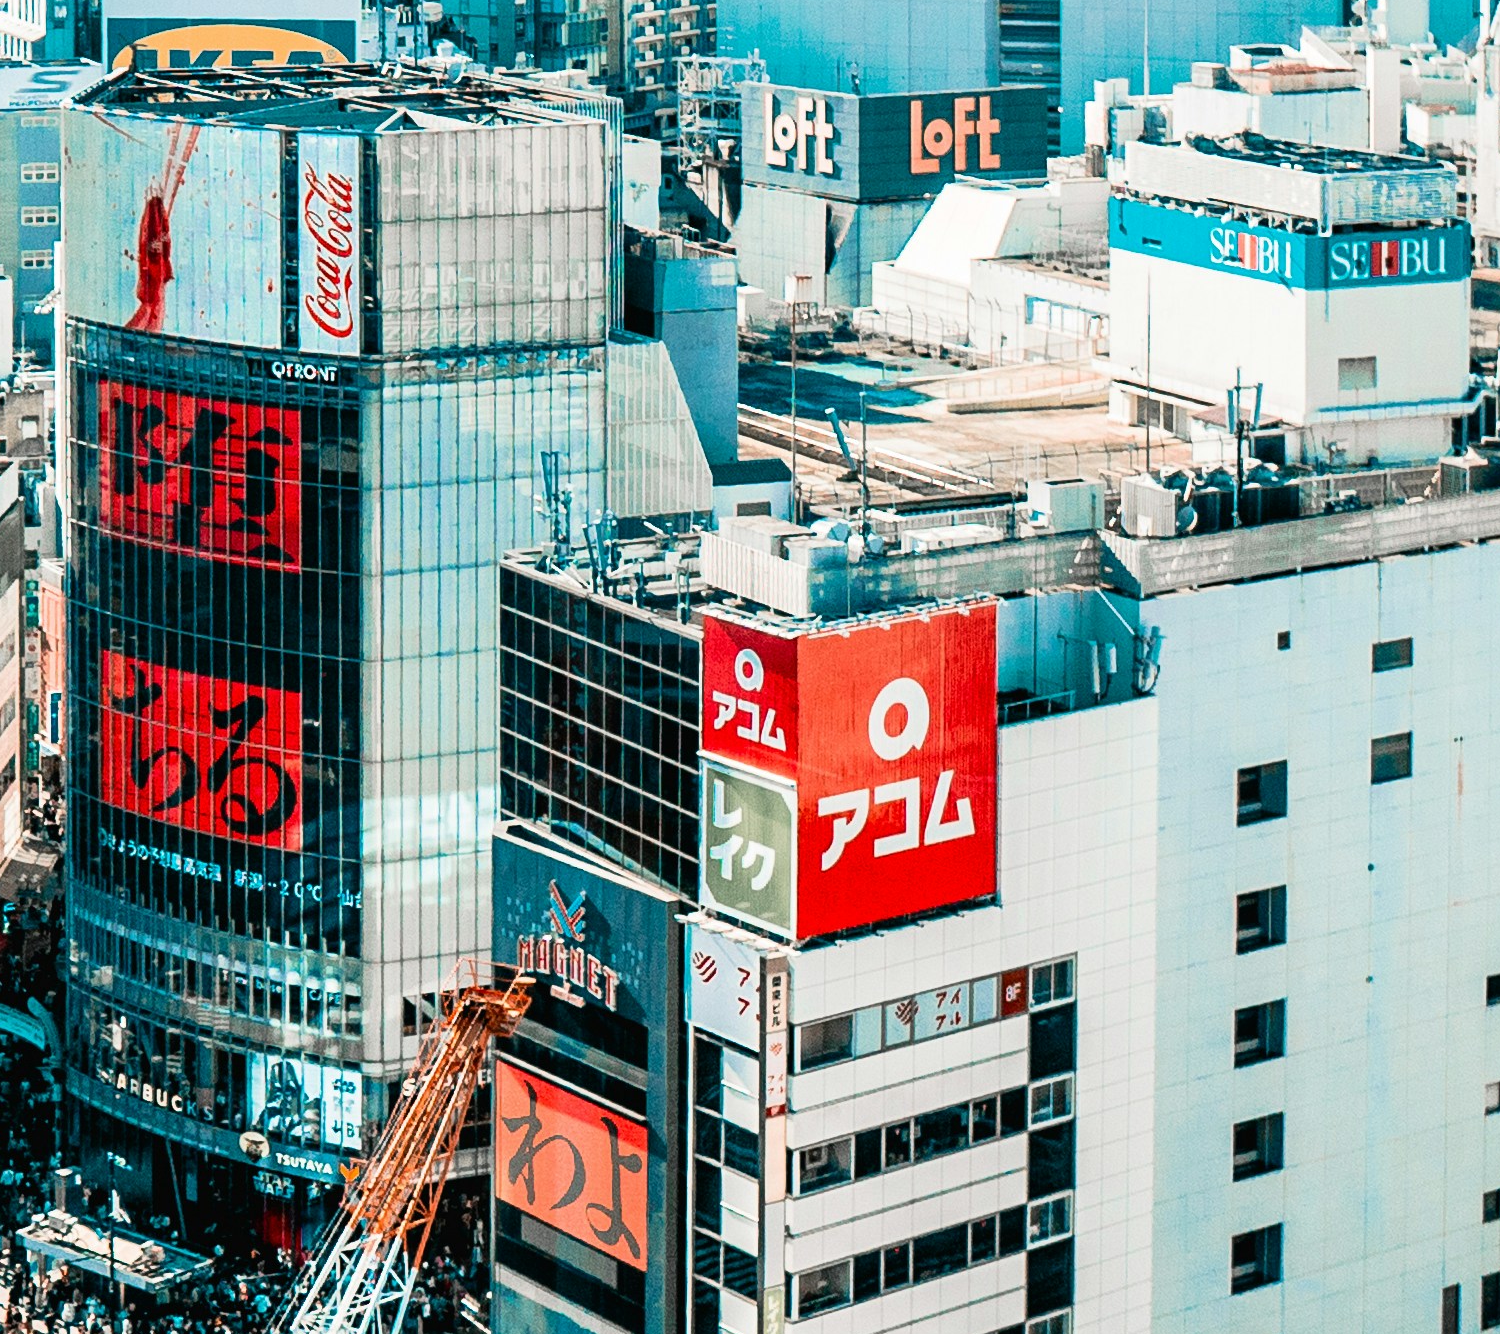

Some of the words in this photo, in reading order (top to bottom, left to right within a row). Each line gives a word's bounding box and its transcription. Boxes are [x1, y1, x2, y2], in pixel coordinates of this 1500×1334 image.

[271, 360, 338, 383] QFRONT
[110, 661, 299, 837] ちる
[711, 691, 787, 751] アコム
[816, 768, 976, 873] アコム
[516, 937, 621, 1011] MAGNET
[935, 988, 963, 1009] アイ
[1004, 984, 1022, 1006] 8F
[275, 1152, 333, 1176] TSUTAYA
[500, 1078, 644, 1260] わよ
